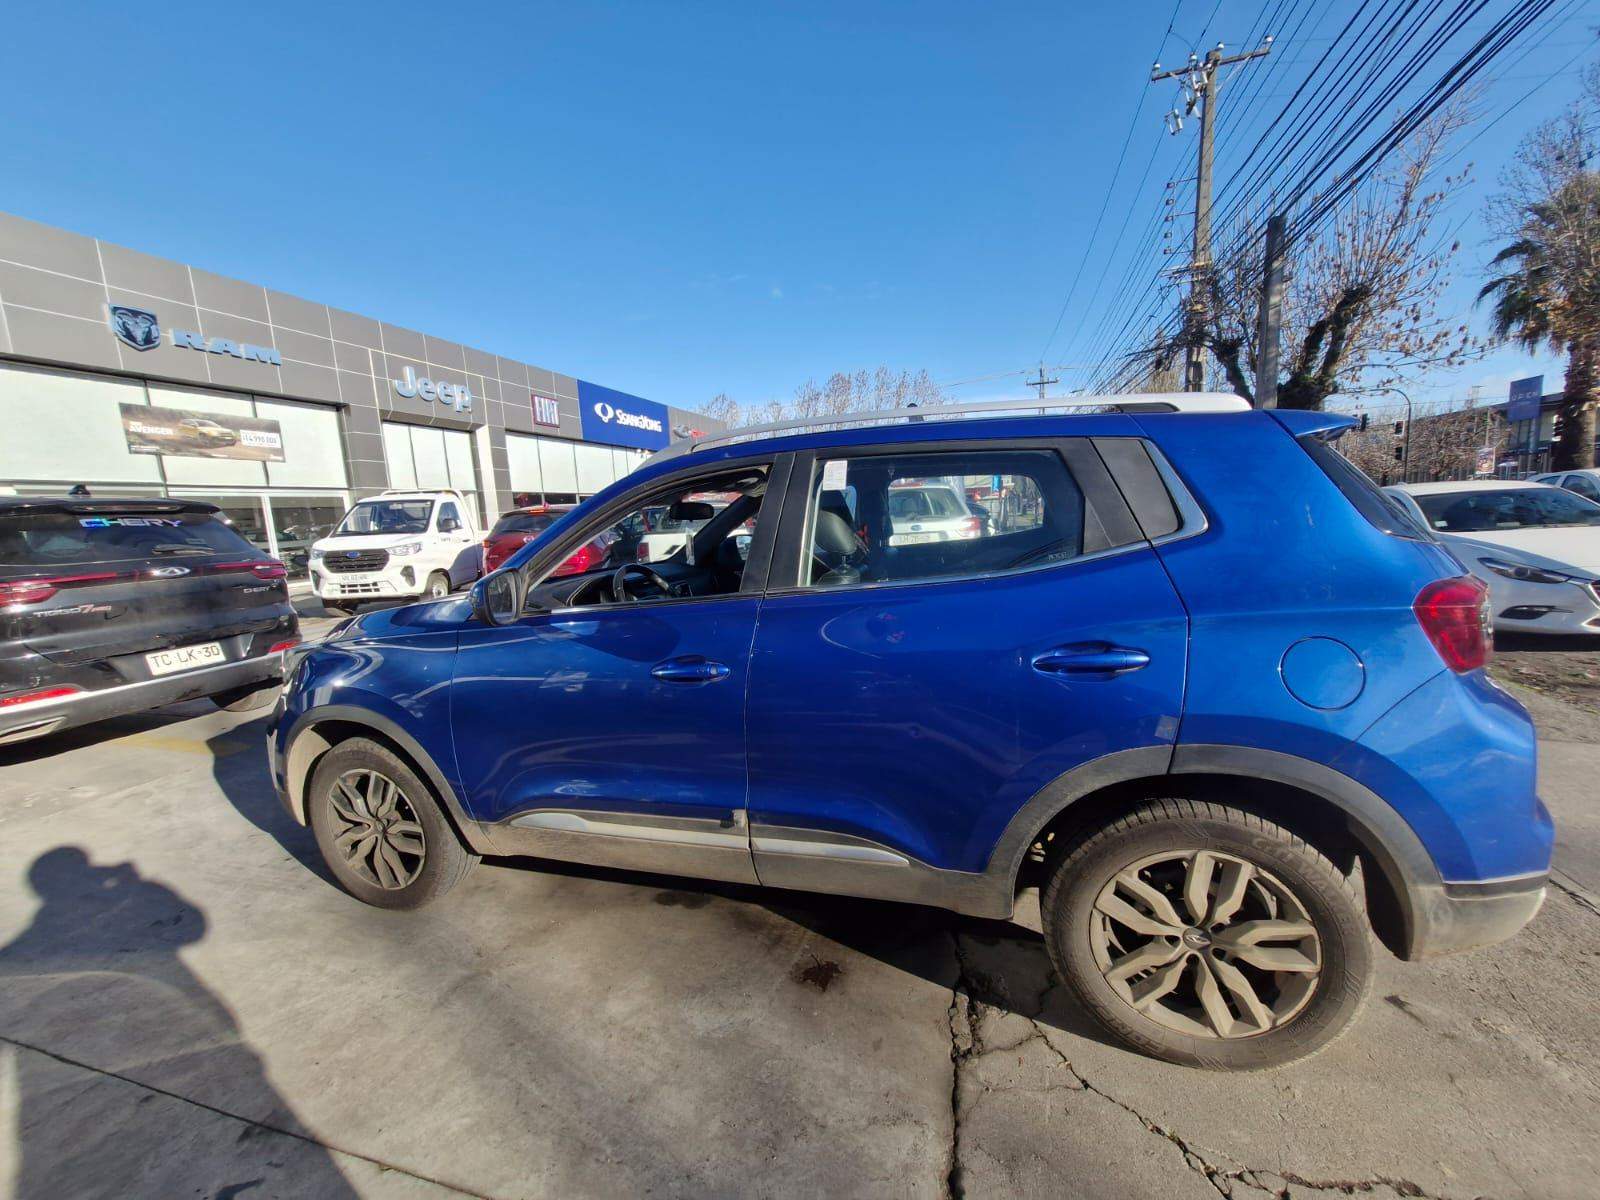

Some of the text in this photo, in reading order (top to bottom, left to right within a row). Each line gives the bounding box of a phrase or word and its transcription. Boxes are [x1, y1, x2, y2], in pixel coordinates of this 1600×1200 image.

[170, 329, 281, 365] RAM
[393, 366, 472, 413] Jeep
[534, 396, 560, 425] FIAT
[79, 517, 185, 528] CHERY
